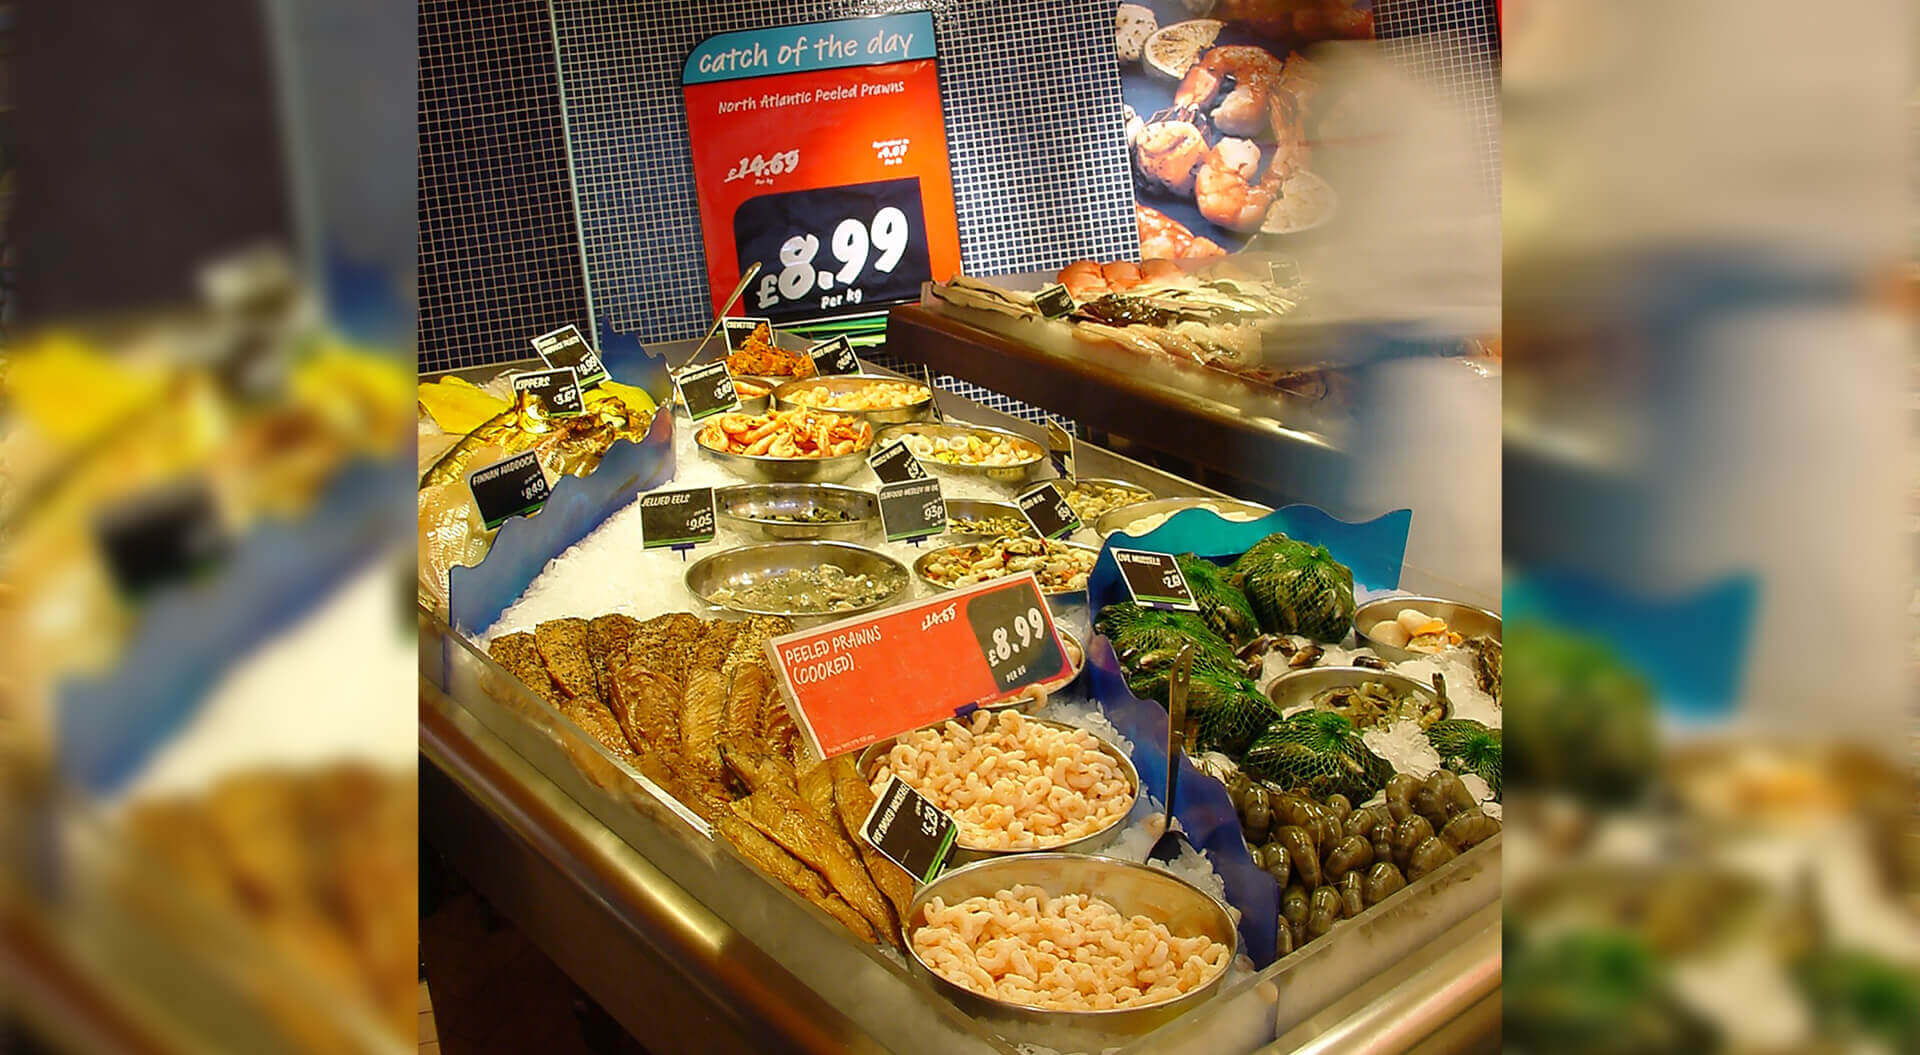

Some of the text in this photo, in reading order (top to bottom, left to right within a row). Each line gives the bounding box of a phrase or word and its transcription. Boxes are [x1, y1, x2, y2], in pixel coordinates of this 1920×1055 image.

[699, 29, 914, 73] catch of the day
[718, 80, 905, 114] North Atlantic Peeled Prawns
[756, 206, 909, 309] £8.99
[820, 288, 863, 310] Per kg
[671, 493, 690, 505] EELS
[785, 625, 882, 666] PEELED PRAWNS
[988, 607, 1044, 667] £8.99
[793, 652, 855, 685] (COOKED)
